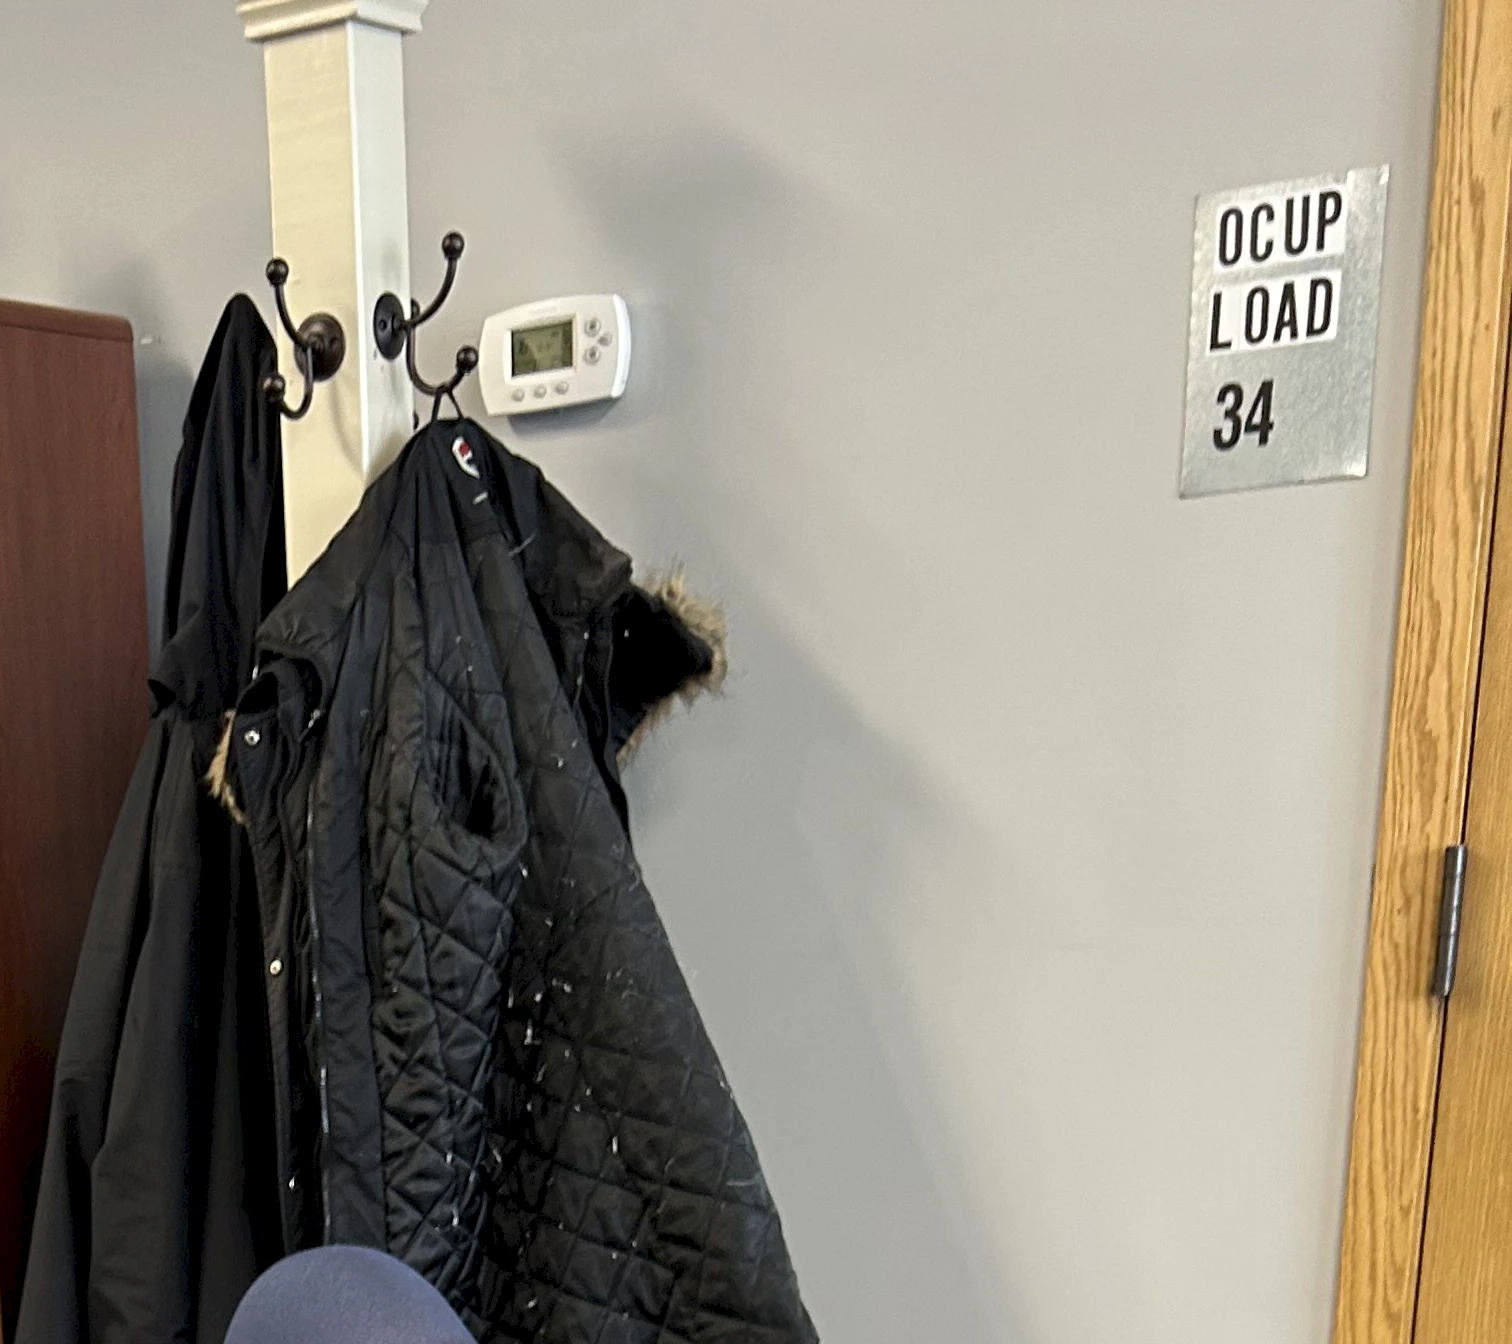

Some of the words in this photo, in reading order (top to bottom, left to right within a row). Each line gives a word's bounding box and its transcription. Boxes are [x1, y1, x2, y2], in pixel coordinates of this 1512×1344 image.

[1218, 190, 1343, 267] OCUP
[1209, 277, 1334, 352] LOAD
[1212, 377, 1276, 452] 34
